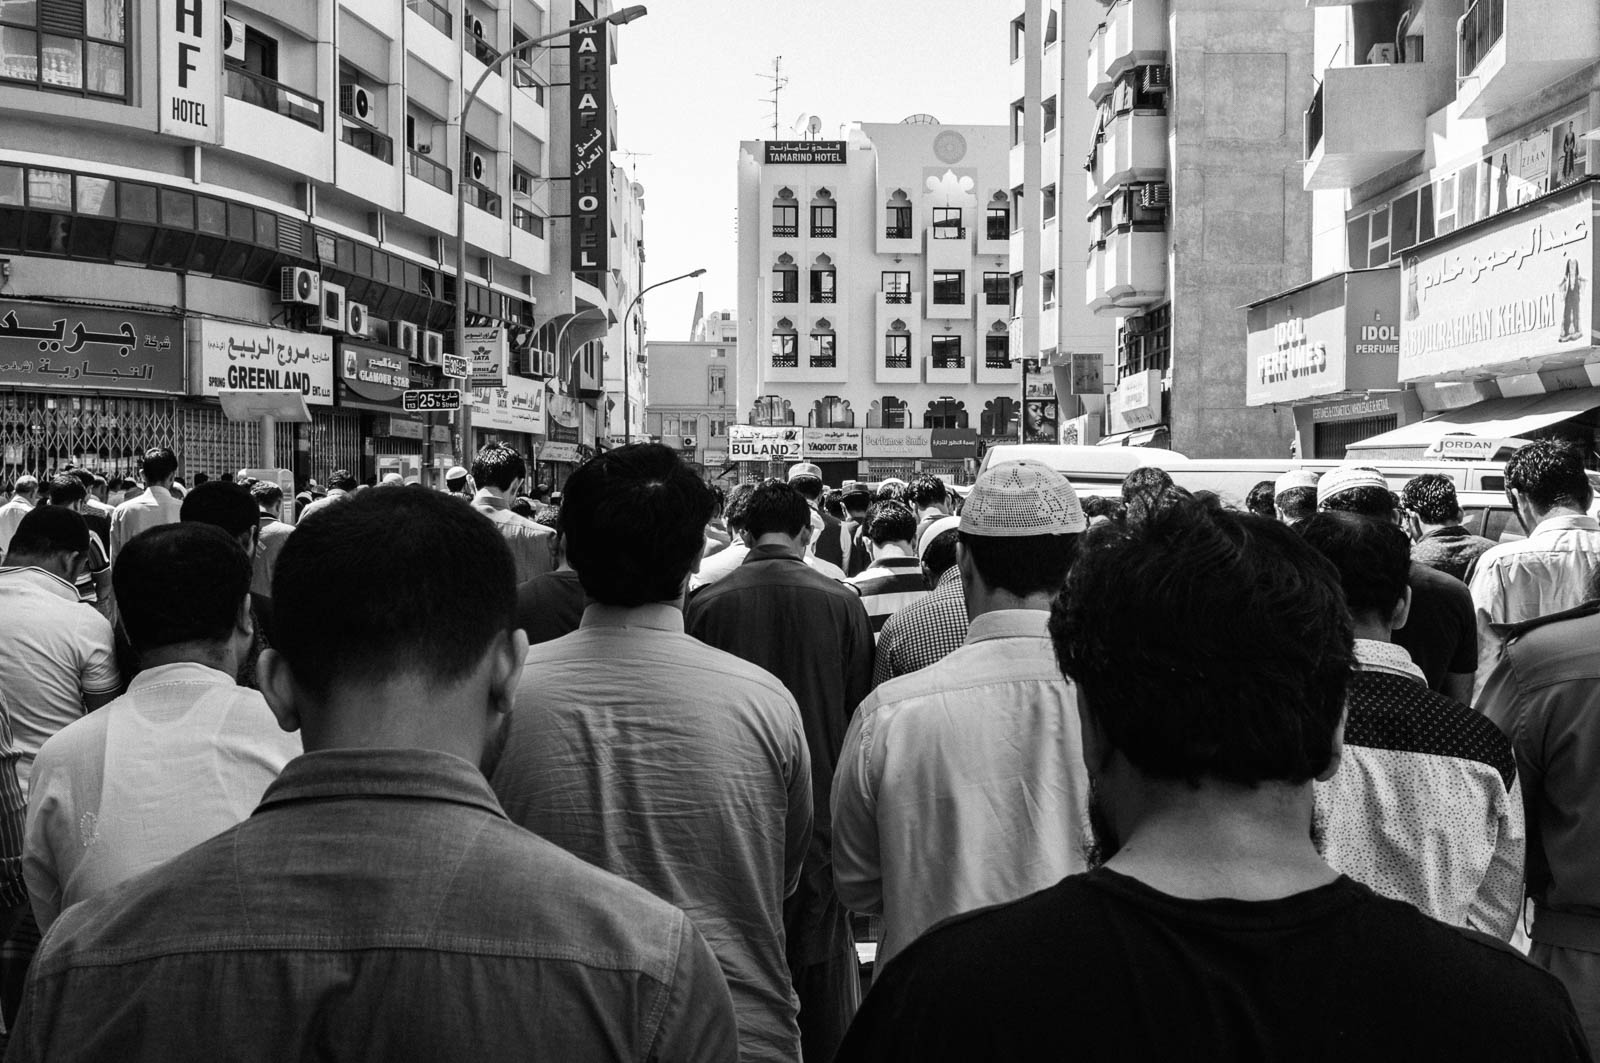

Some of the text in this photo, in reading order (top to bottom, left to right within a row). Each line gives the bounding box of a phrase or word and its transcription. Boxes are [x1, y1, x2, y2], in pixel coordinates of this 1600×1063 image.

[577, 37, 599, 128] ARRAF
[172, 96, 208, 127] HOTEL
[574, 127, 602, 157] فندق
[574, 145, 604, 176] العراف
[769, 152, 842, 162] TAMARIND HOTEL
[578, 177, 599, 267] HOTEL
[1497, 292, 1556, 337] KHADIM
[1273, 317, 1306, 346] IDOL
[1360, 325, 1399, 341] IDOL
[1257, 340, 1327, 379] PERFUMES
[1355, 344, 1399, 354] PERFUME
[208, 376, 226, 388] SPRING
[227, 364, 311, 397] GREENLAND
[359, 369, 392, 385] GLAMOUR
[392, 375, 410, 388] STAR
[420, 393, 435, 408] 25
[732, 443, 789, 455] BULAND
[790, 443, 801, 455] 2
[838, 443, 858, 452] STAR
[865, 434, 928, 446] Perfumes Smile
[1433, 441, 1492, 453] JORDAN
